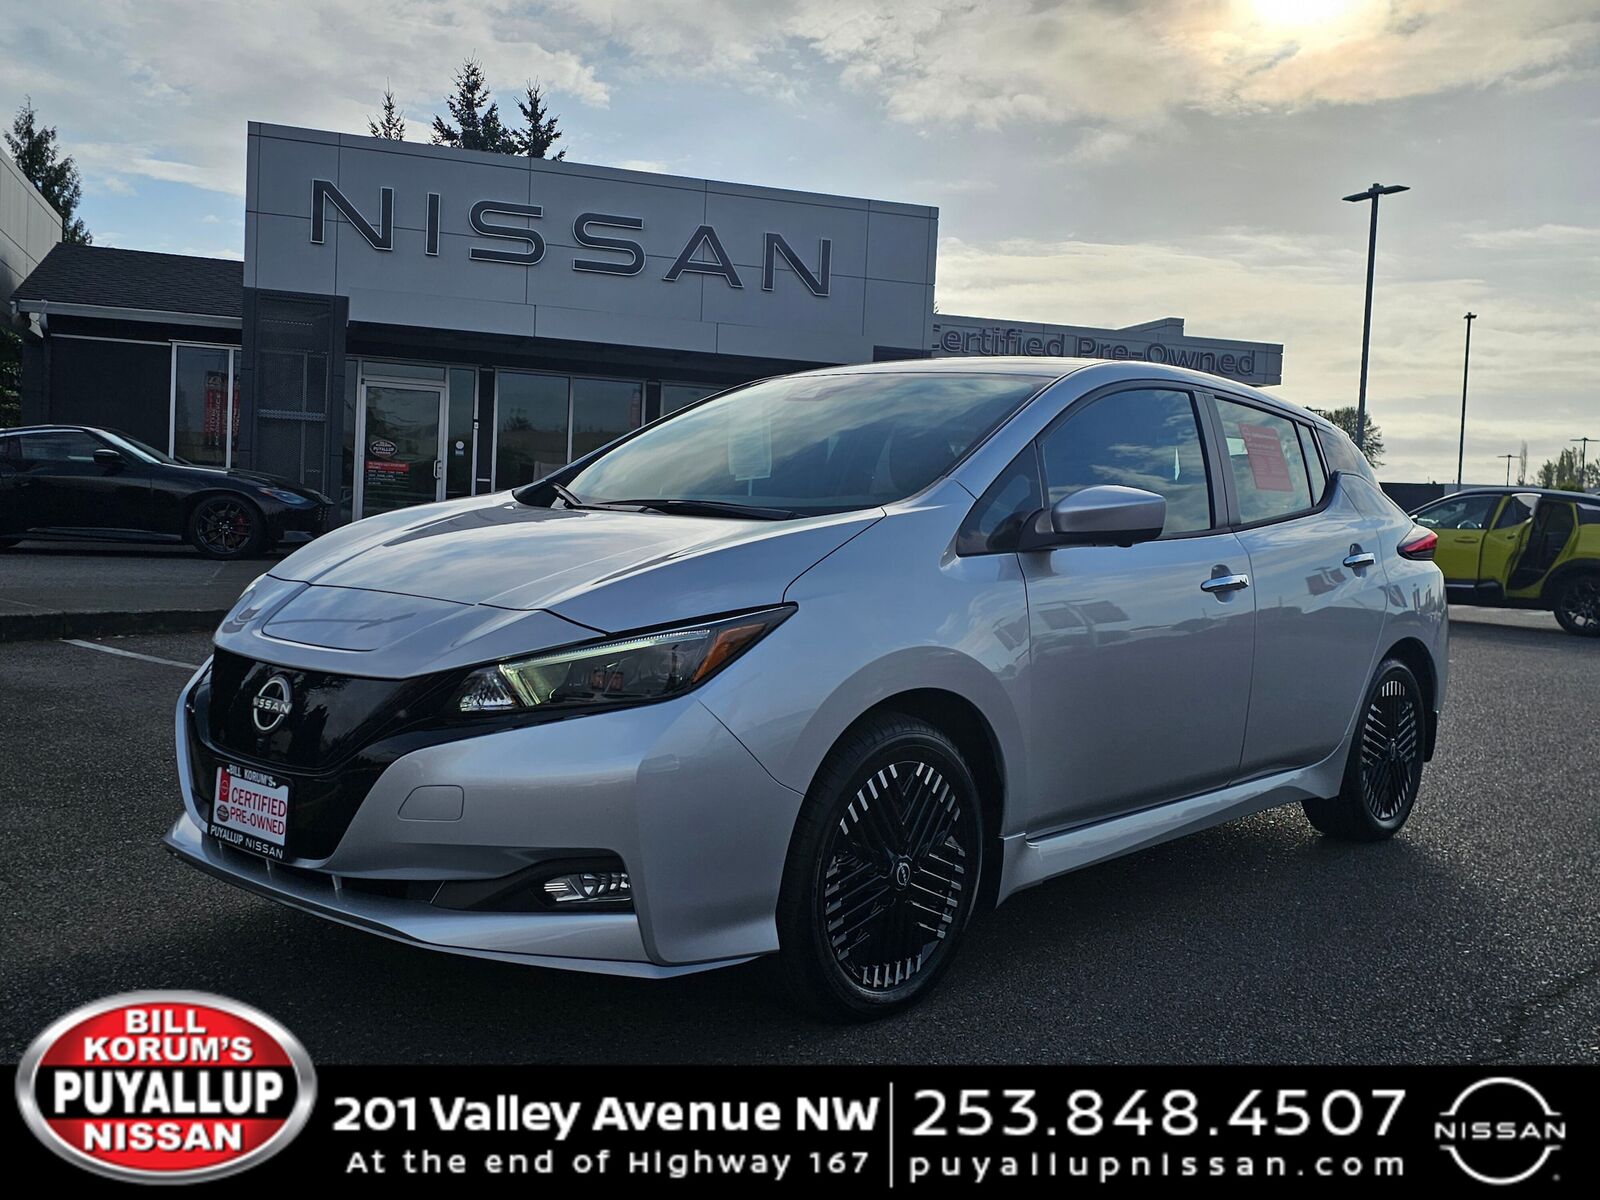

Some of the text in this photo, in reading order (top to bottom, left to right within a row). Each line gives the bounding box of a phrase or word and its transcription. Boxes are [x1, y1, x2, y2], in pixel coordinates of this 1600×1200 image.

[310, 178, 833, 297] NISSAN
[1077, 335, 1256, 376] Pre-Owned
[228, 764, 274, 787] BILL KORUM'S
[231, 787, 287, 818] CERTIFIED
[230, 806, 285, 836] PRE-OWNED
[210, 824, 284, 859] PUYALLUP NISSAN
